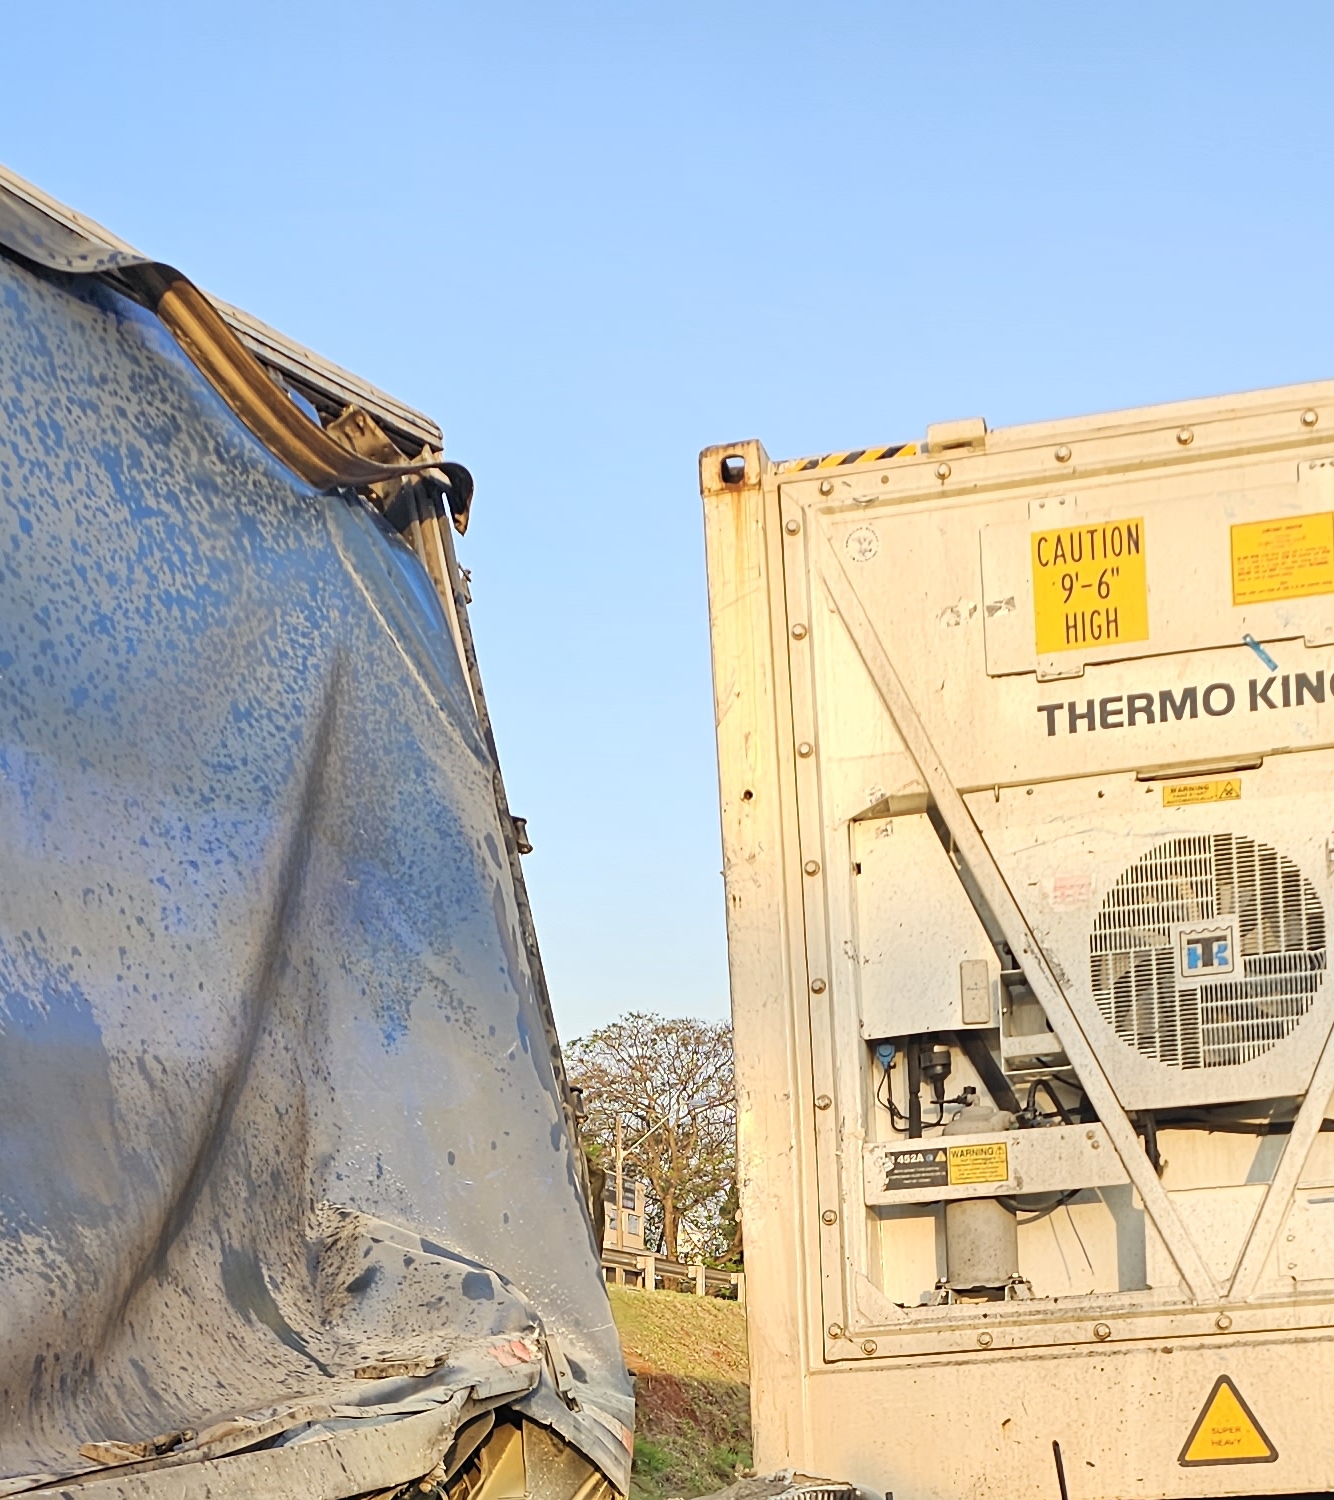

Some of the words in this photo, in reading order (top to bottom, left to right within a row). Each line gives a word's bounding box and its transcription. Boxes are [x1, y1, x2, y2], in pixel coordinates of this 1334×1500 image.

[1036, 523, 1142, 568] CAUTION
[1064, 607, 1120, 645] HIGH
[1037, 681, 1236, 738] THERMO
[951, 1147, 994, 1158] WARNING
[1210, 1425, 1242, 1435] SUPER
[1210, 1438, 1242, 1447] HEAVY
